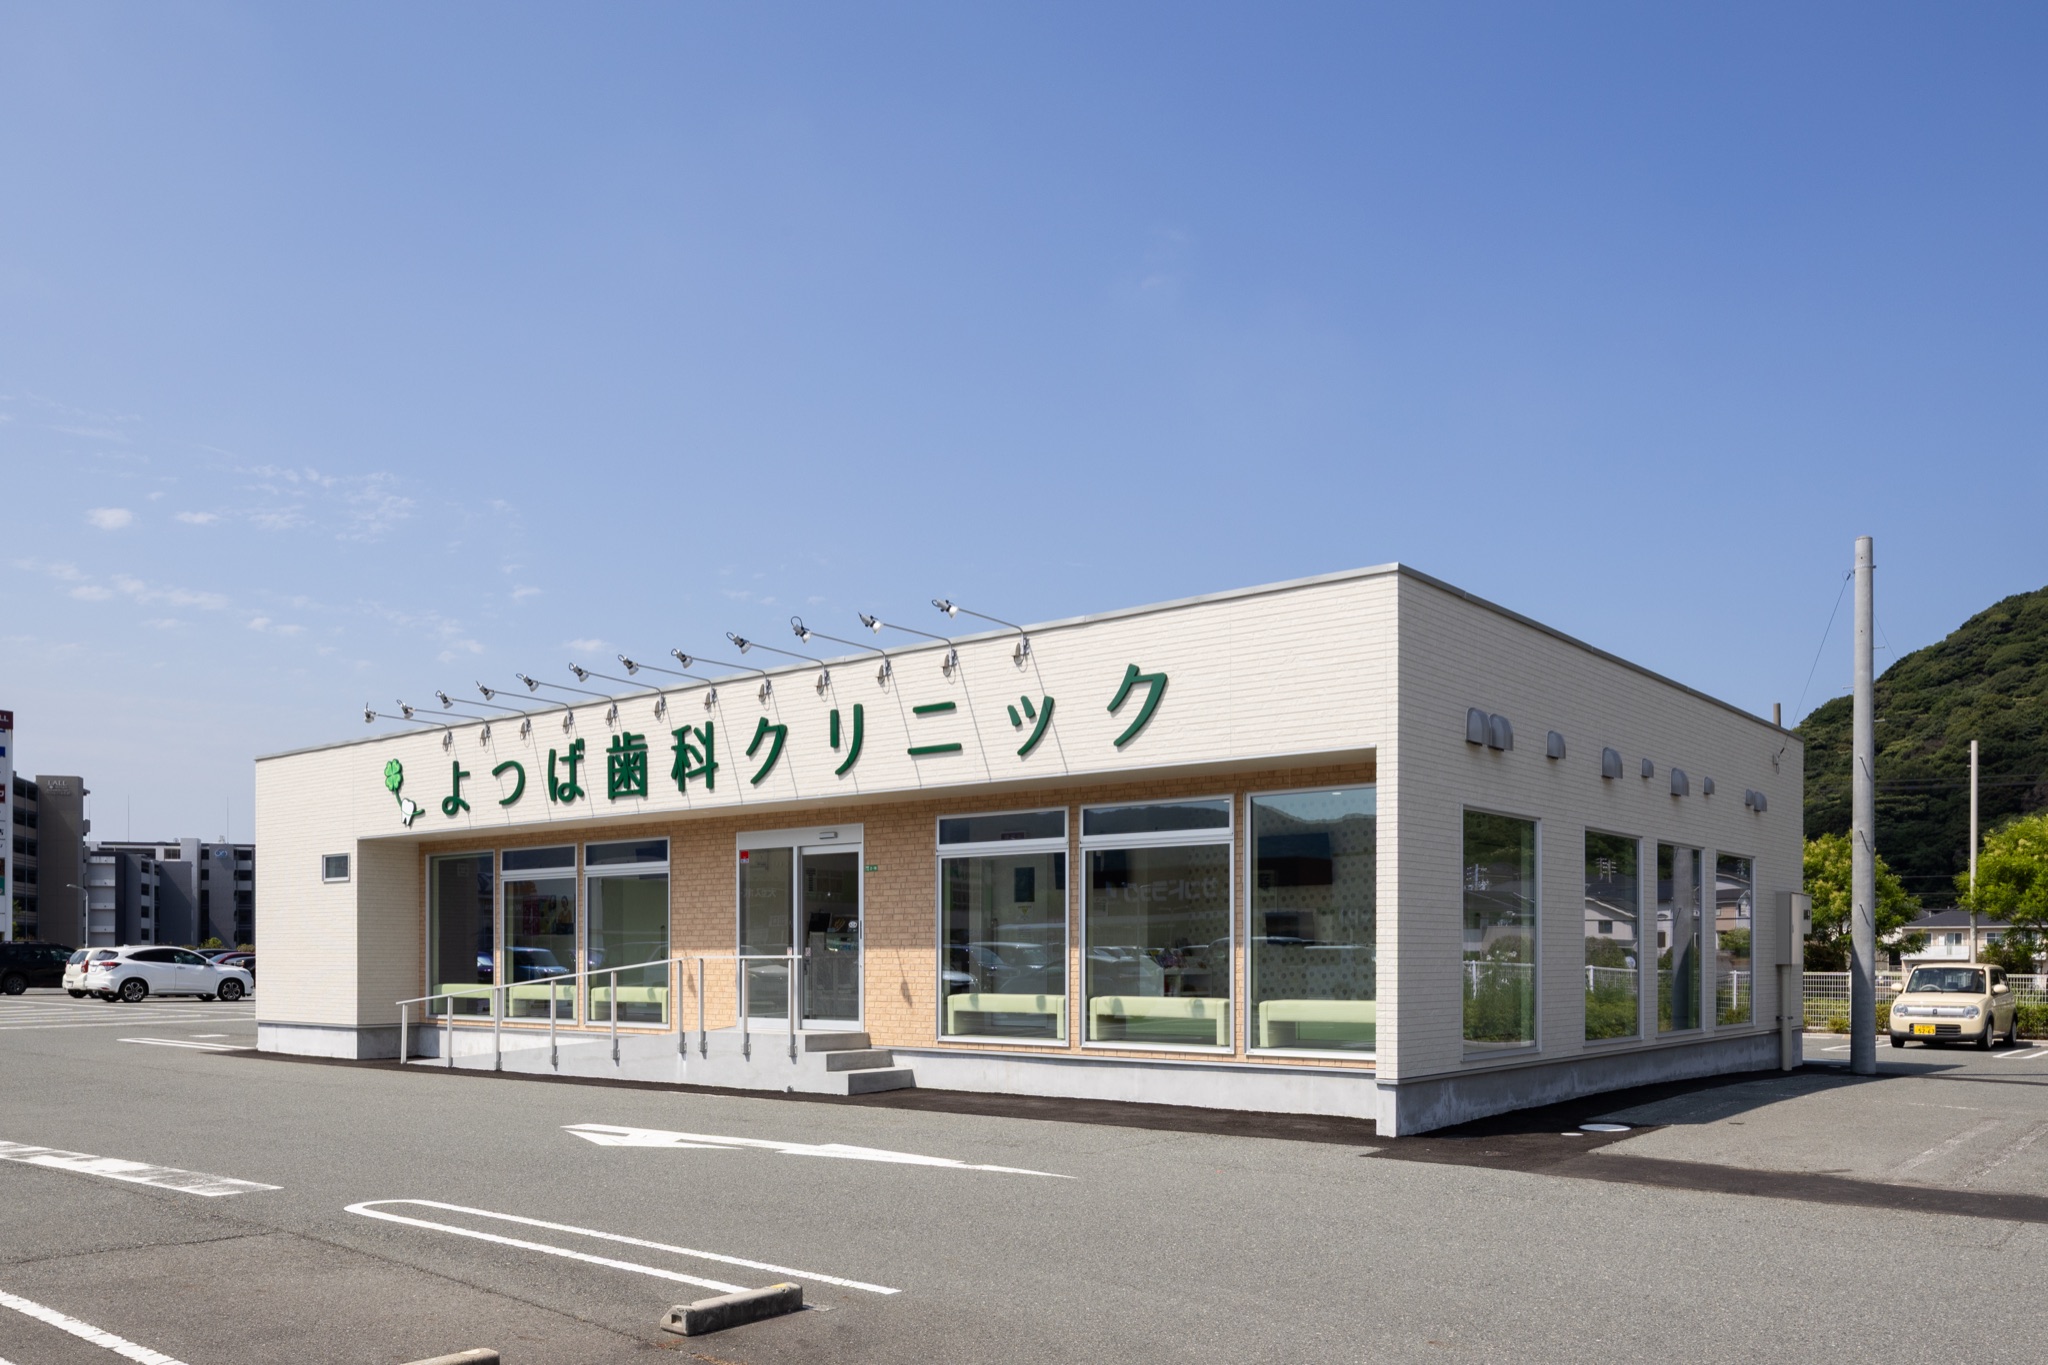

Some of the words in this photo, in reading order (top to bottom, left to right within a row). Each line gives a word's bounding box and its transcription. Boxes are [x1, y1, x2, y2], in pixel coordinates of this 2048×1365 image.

[441, 663, 1169, 816] よつば歯科クリニック
